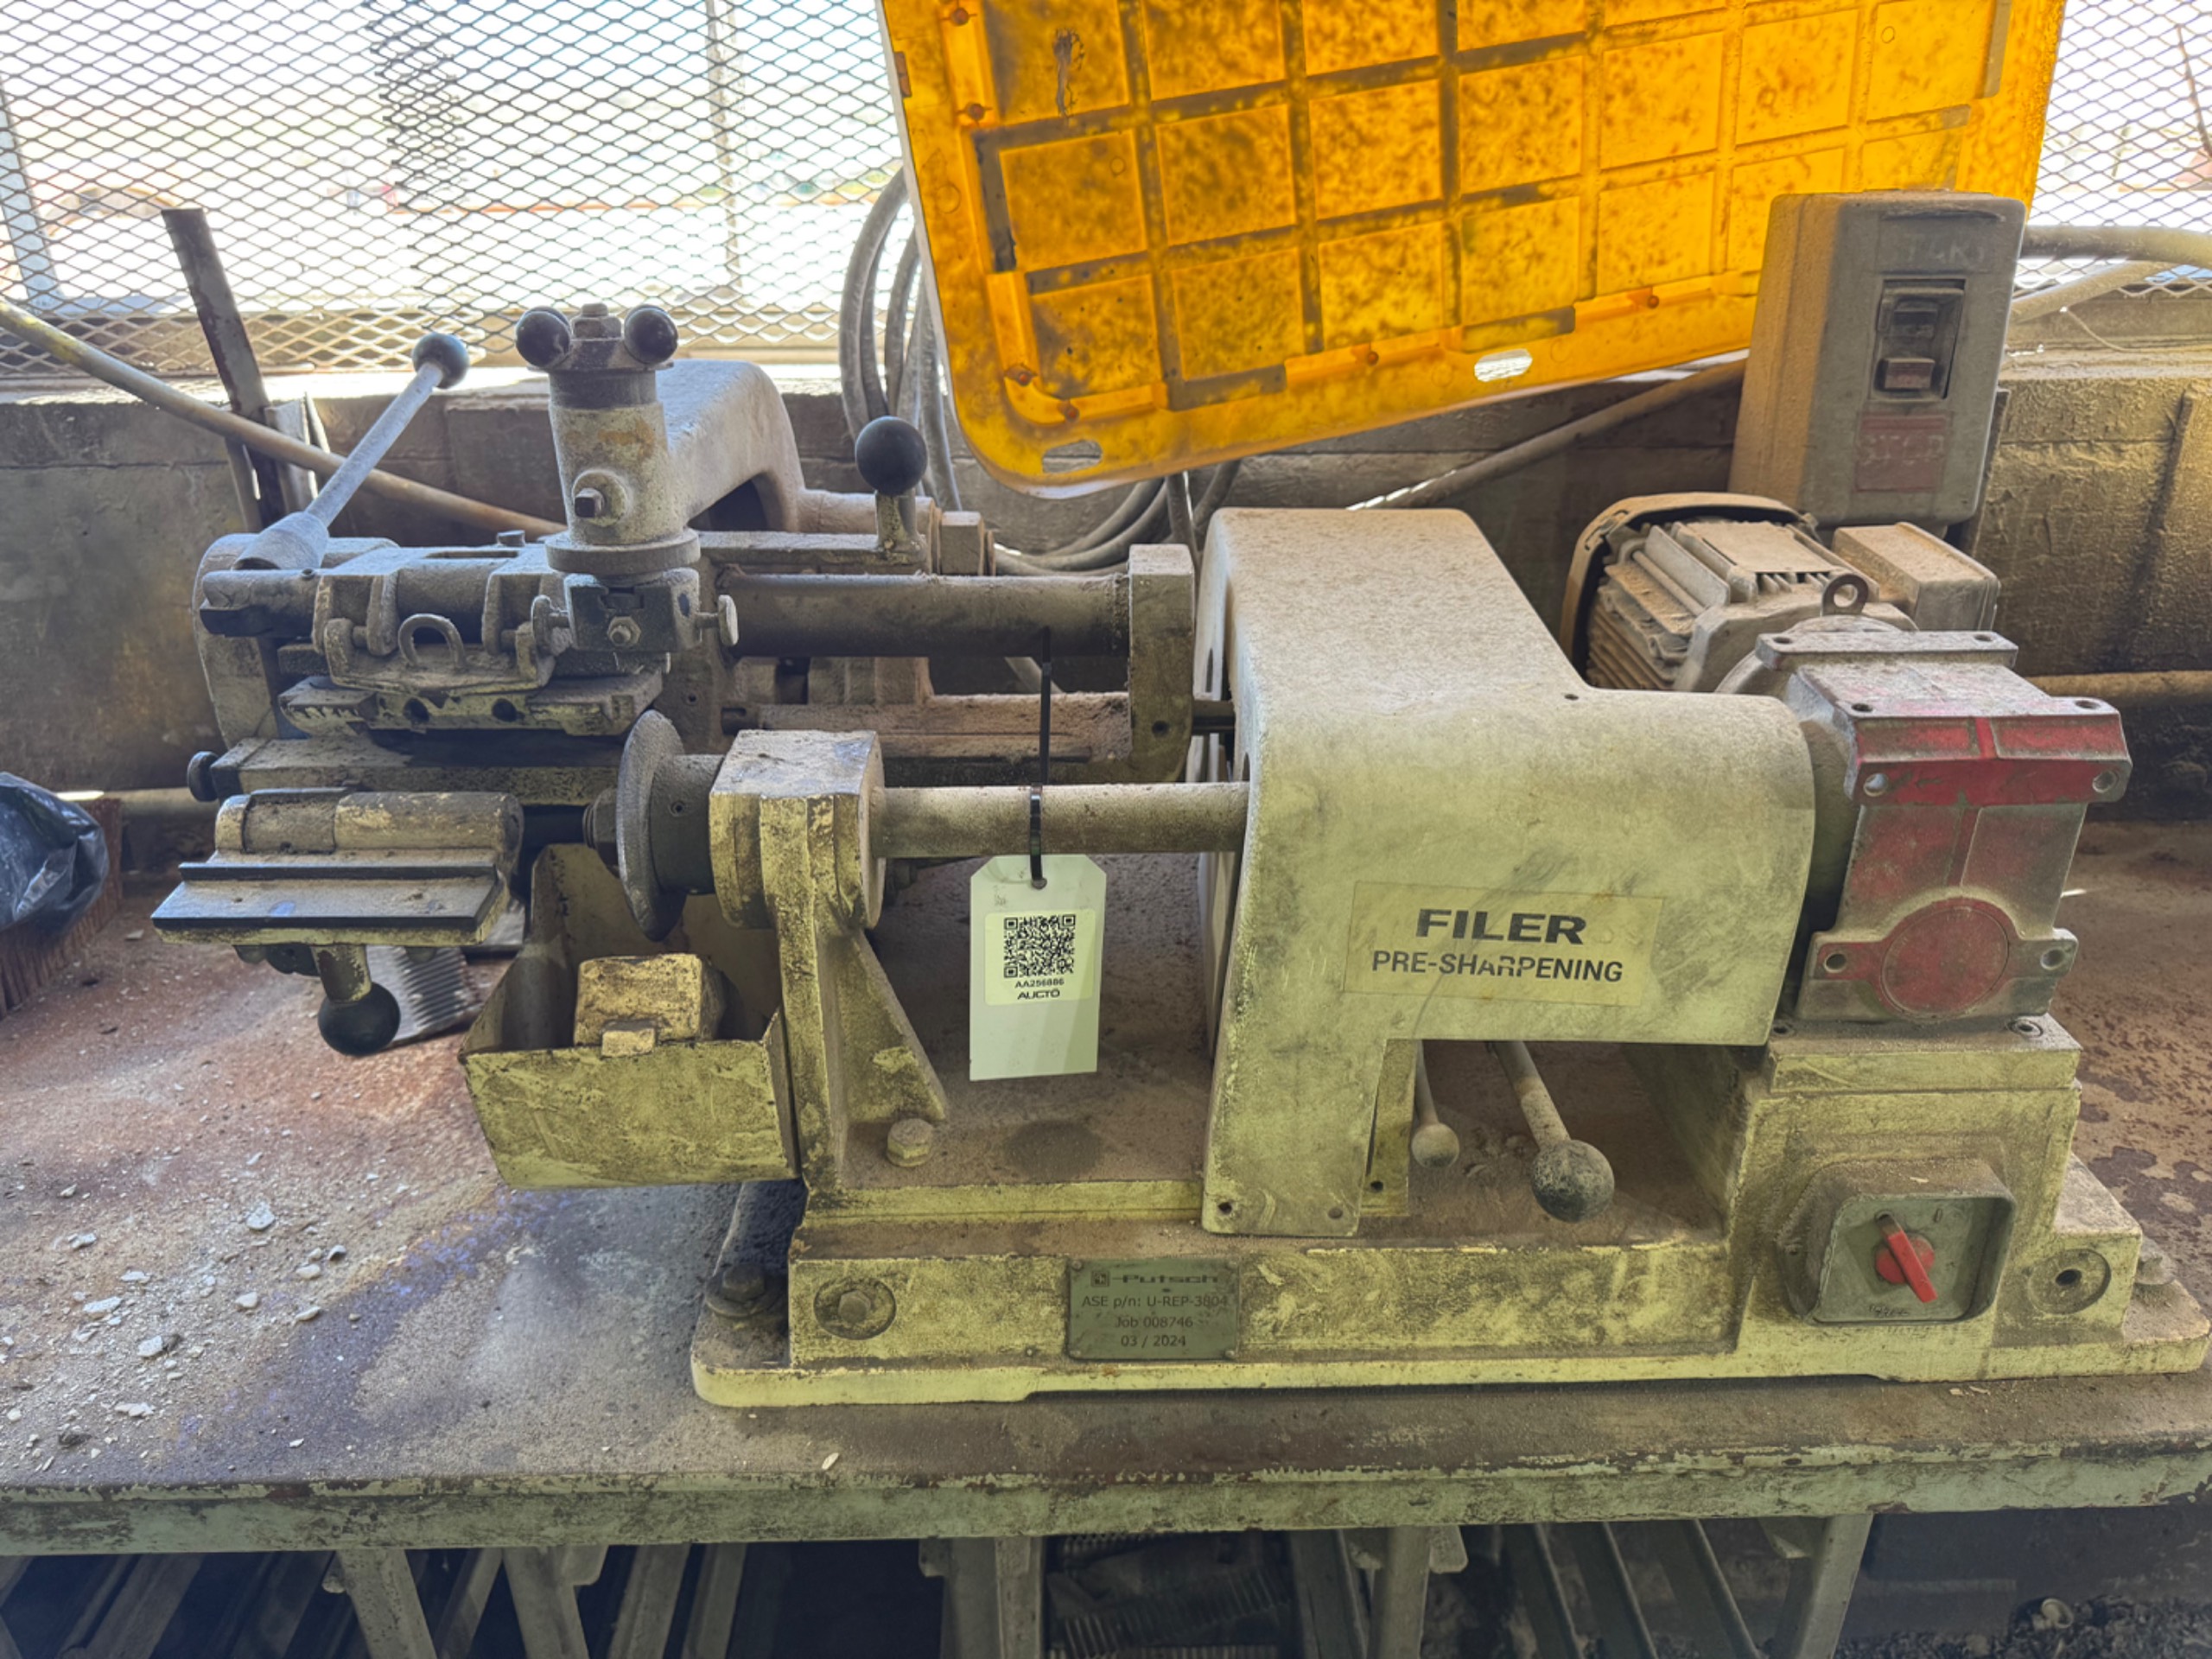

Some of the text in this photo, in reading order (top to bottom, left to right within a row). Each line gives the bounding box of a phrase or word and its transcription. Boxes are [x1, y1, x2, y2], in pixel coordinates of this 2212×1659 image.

[1415, 908, 1586, 945] FILER
[1371, 950, 1624, 982] PRE-SHARPENING
[1017, 988, 1060, 1000] AUCTO
[1122, 1274, 1218, 1283] Putsch
[1082, 1296, 1109, 1307] ASE
[1113, 1296, 1141, 1309] p/n:
[1115, 1316, 1193, 1328] Job 008746
[1121, 1336, 1138, 1347] 03
[1153, 1335, 1186, 1347] 2024
